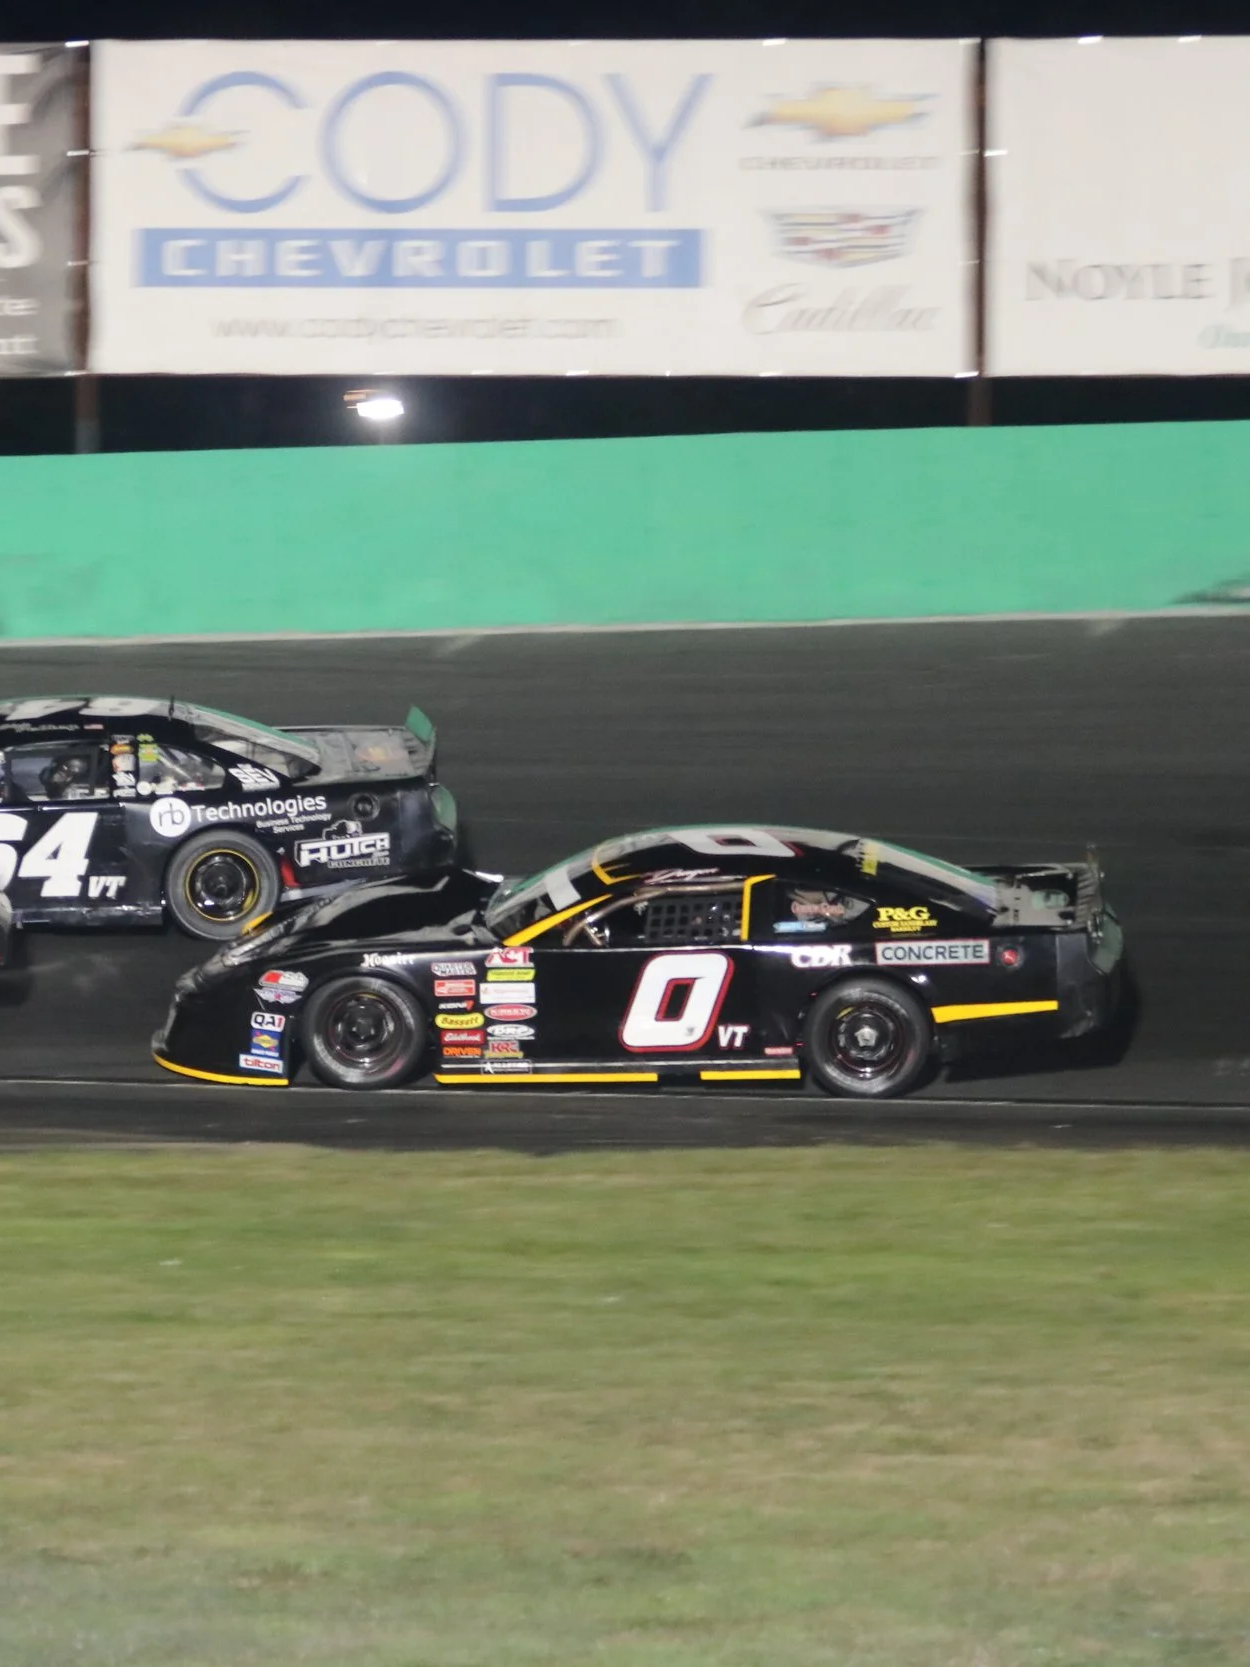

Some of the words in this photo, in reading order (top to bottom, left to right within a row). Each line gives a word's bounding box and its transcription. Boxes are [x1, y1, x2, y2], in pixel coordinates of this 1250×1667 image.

[177, 70, 719, 214] CODY
[160, 237, 683, 279] CHEVROLET
[739, 283, 944, 335] Cadillac
[191, 795, 328, 823] Technologies
[256, 819, 289, 828] Business
[290, 813, 332, 824] Technology
[272, 823, 305, 834] Services
[88, 876, 127, 898] VT
[876, 906, 931, 921] P&G
[881, 944, 984, 961] CONCRETE
[618, 949, 735, 1053] 0
[254, 1013, 283, 1028] QA1
[441, 1016, 479, 1026] Bassett
[717, 1024, 750, 1048] VT
[244, 1058, 280, 1070] tilton
